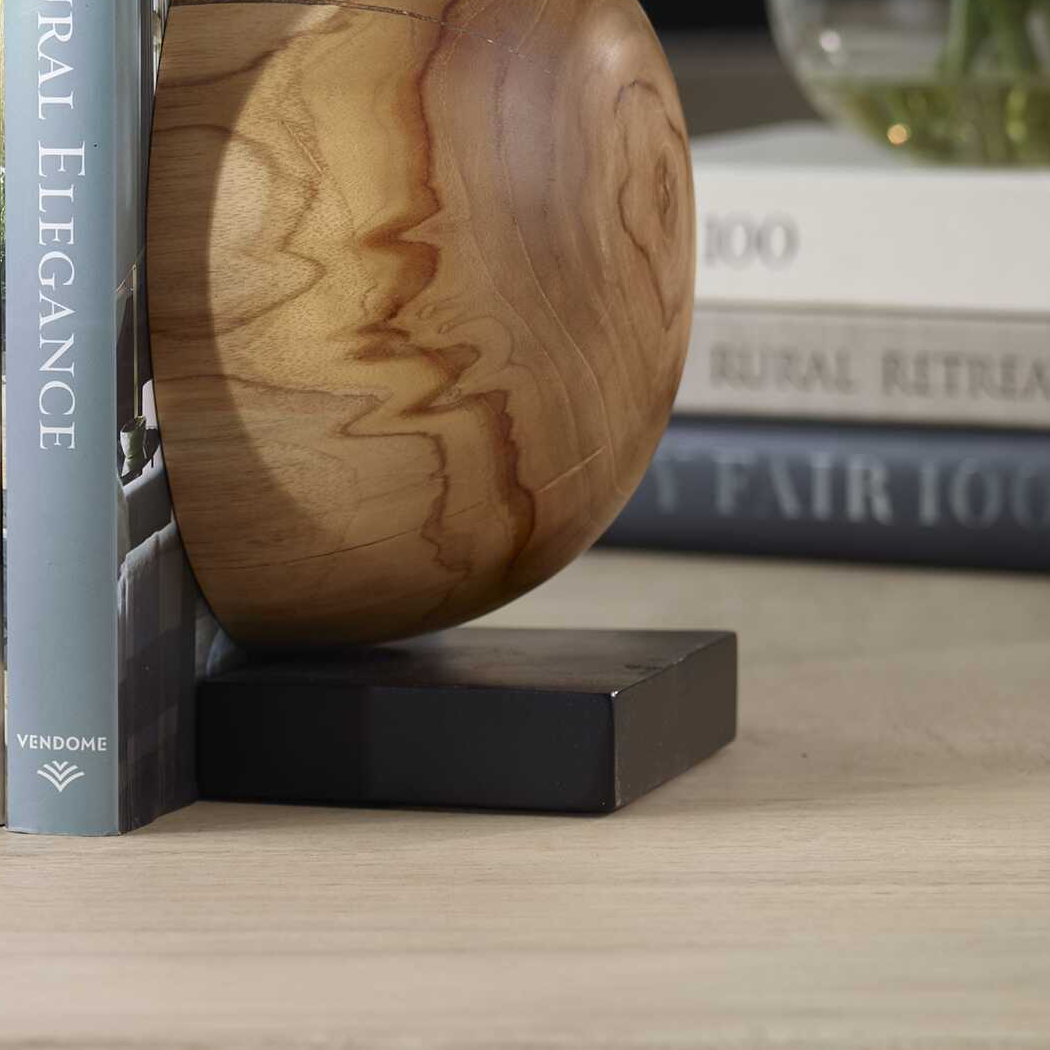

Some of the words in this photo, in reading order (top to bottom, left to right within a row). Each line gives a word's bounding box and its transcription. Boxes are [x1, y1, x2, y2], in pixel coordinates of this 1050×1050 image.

[37, 140, 86, 450] ELEGANCE
[709, 344, 856, 394] RURAL
[714, 450, 893, 525] FAIR
[17, 733, 107, 751] VENDOME
